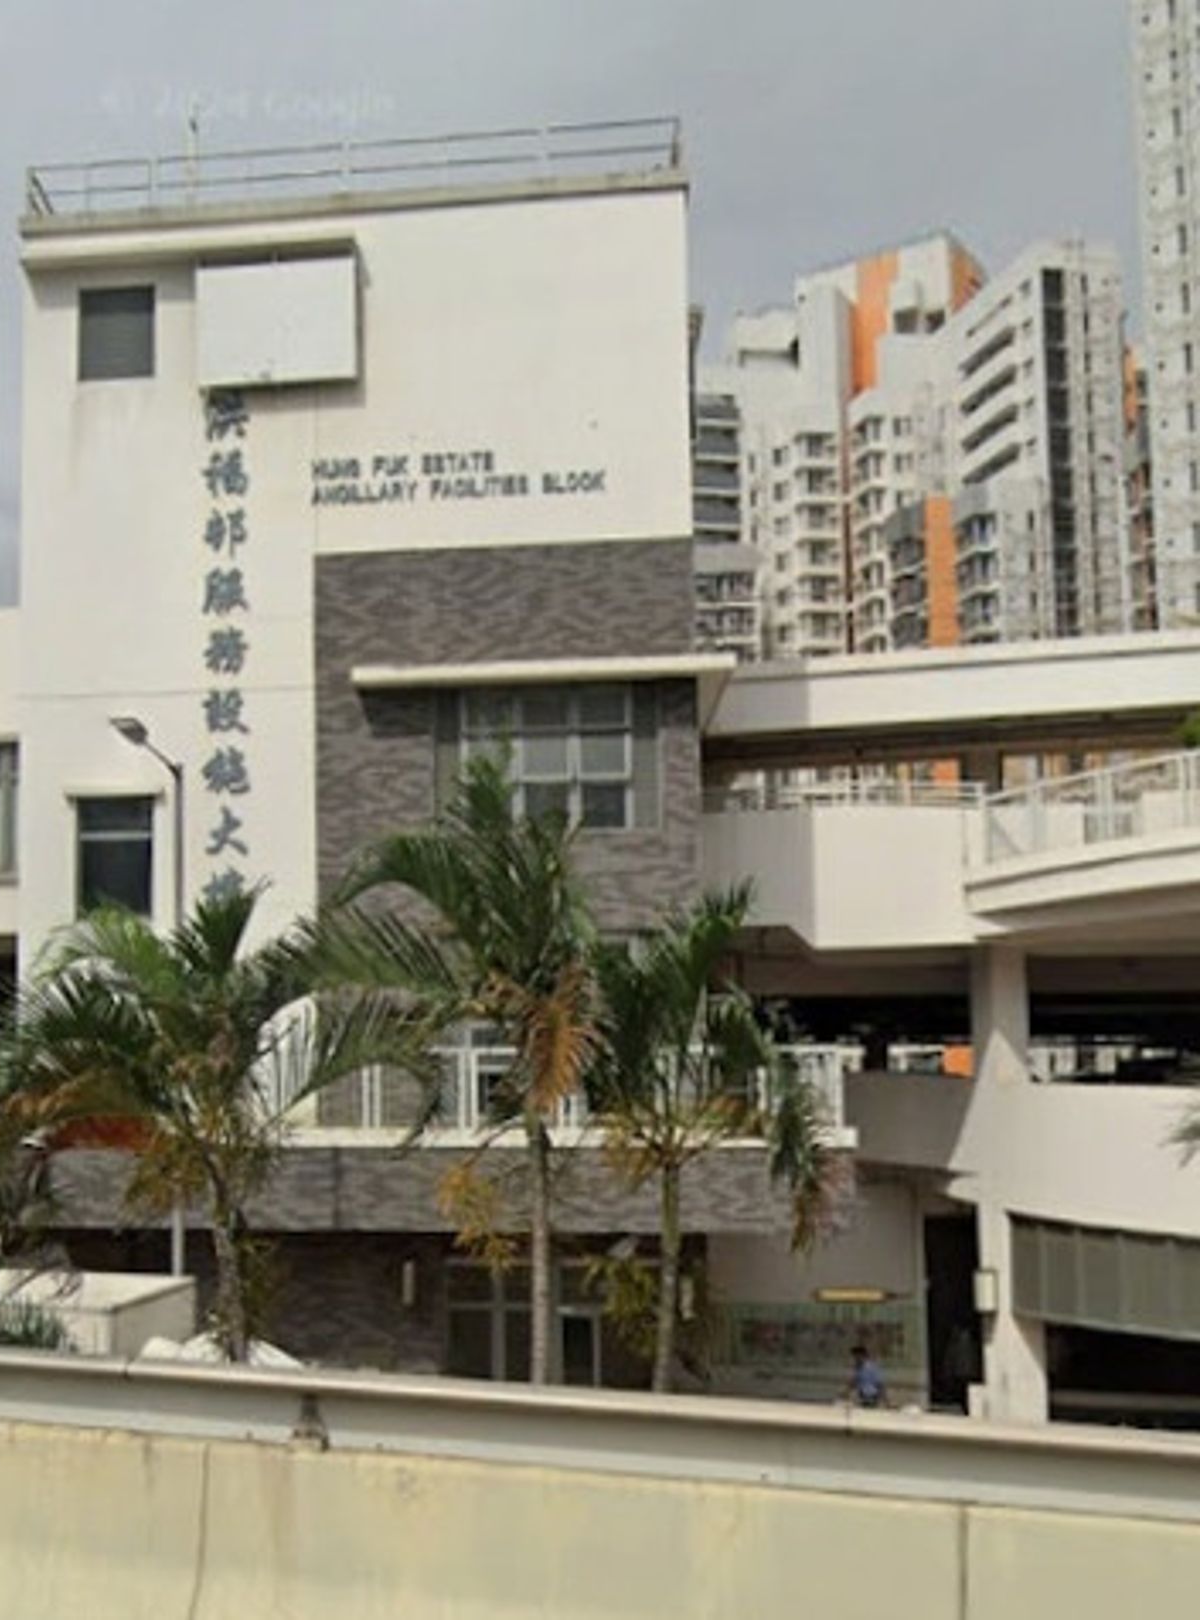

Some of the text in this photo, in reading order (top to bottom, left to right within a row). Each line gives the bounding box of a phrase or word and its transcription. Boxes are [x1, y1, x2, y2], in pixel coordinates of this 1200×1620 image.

[311, 450, 495, 480] HUNG FUK ESTATE
[311, 469, 607, 506] ANCILLARY FACILITIES BLOCK
